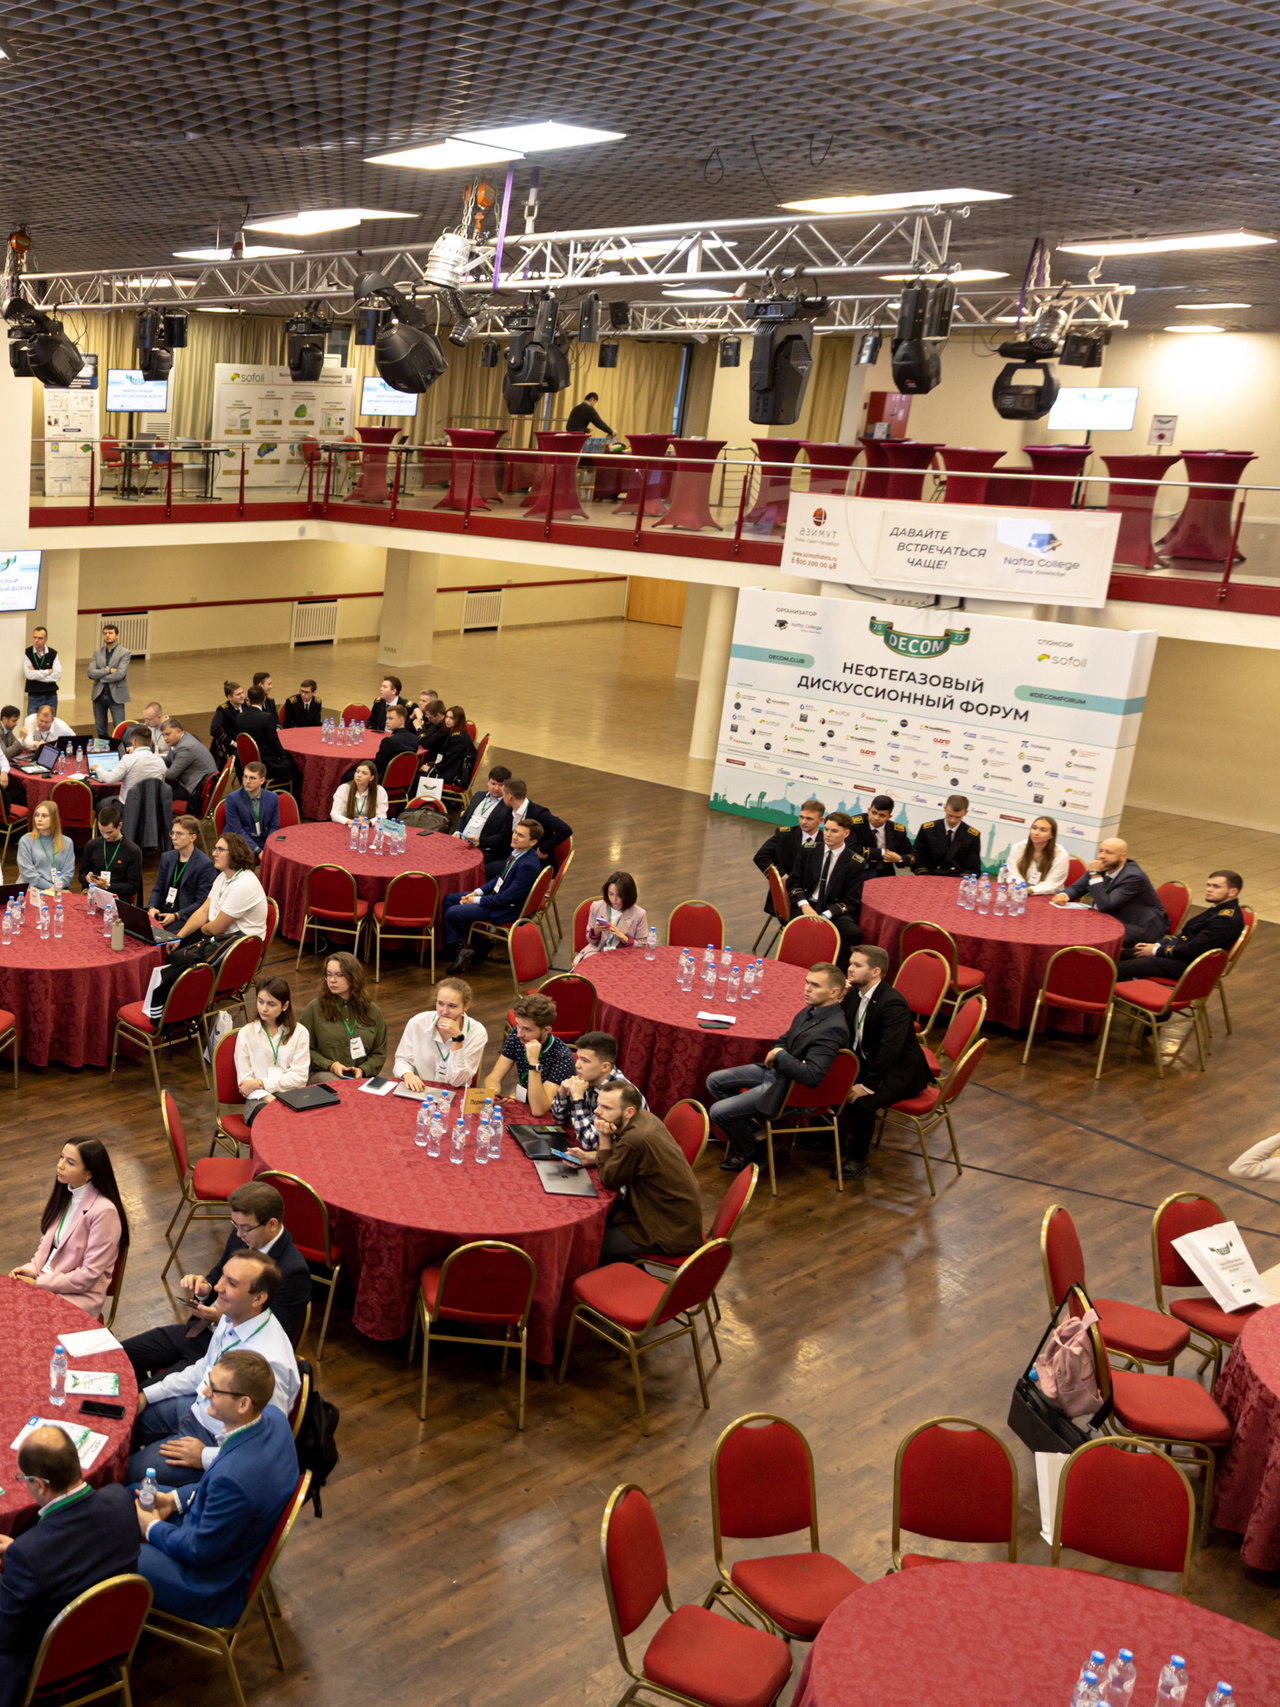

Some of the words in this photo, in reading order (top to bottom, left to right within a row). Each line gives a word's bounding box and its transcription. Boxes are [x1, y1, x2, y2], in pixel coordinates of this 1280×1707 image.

[241, 373, 265, 383] sofoil
[889, 527, 949, 540] ДАВАЙТЕ
[897, 542, 987, 558] ВСТРЕЧАТЬСЯ
[796, 557, 807, 565] 800
[807, 559, 818, 567] 200
[828, 562, 837, 570] 48
[907, 557, 947, 570] ЧАЩЕ!
[1003, 557, 1034, 567] Nafta
[1037, 558, 1080, 571] College
[776, 607, 817, 617] ОРГАНИЗАТОР
[889, 634, 944, 654] DECOM
[1037, 639, 1073, 648] СПОНСОР
[768, 654, 805, 664] DECOM.CLUB
[1051, 656, 1087, 668] sofoil
[842, 662, 984, 694] НЕФТЕГАЗОВЫЙ
[797, 675, 954, 710] ДИСКУССИОННЫЙ
[959, 700, 1030, 722] ФОРУМ
[1029, 692, 1086, 705] #DECOMFORUM
